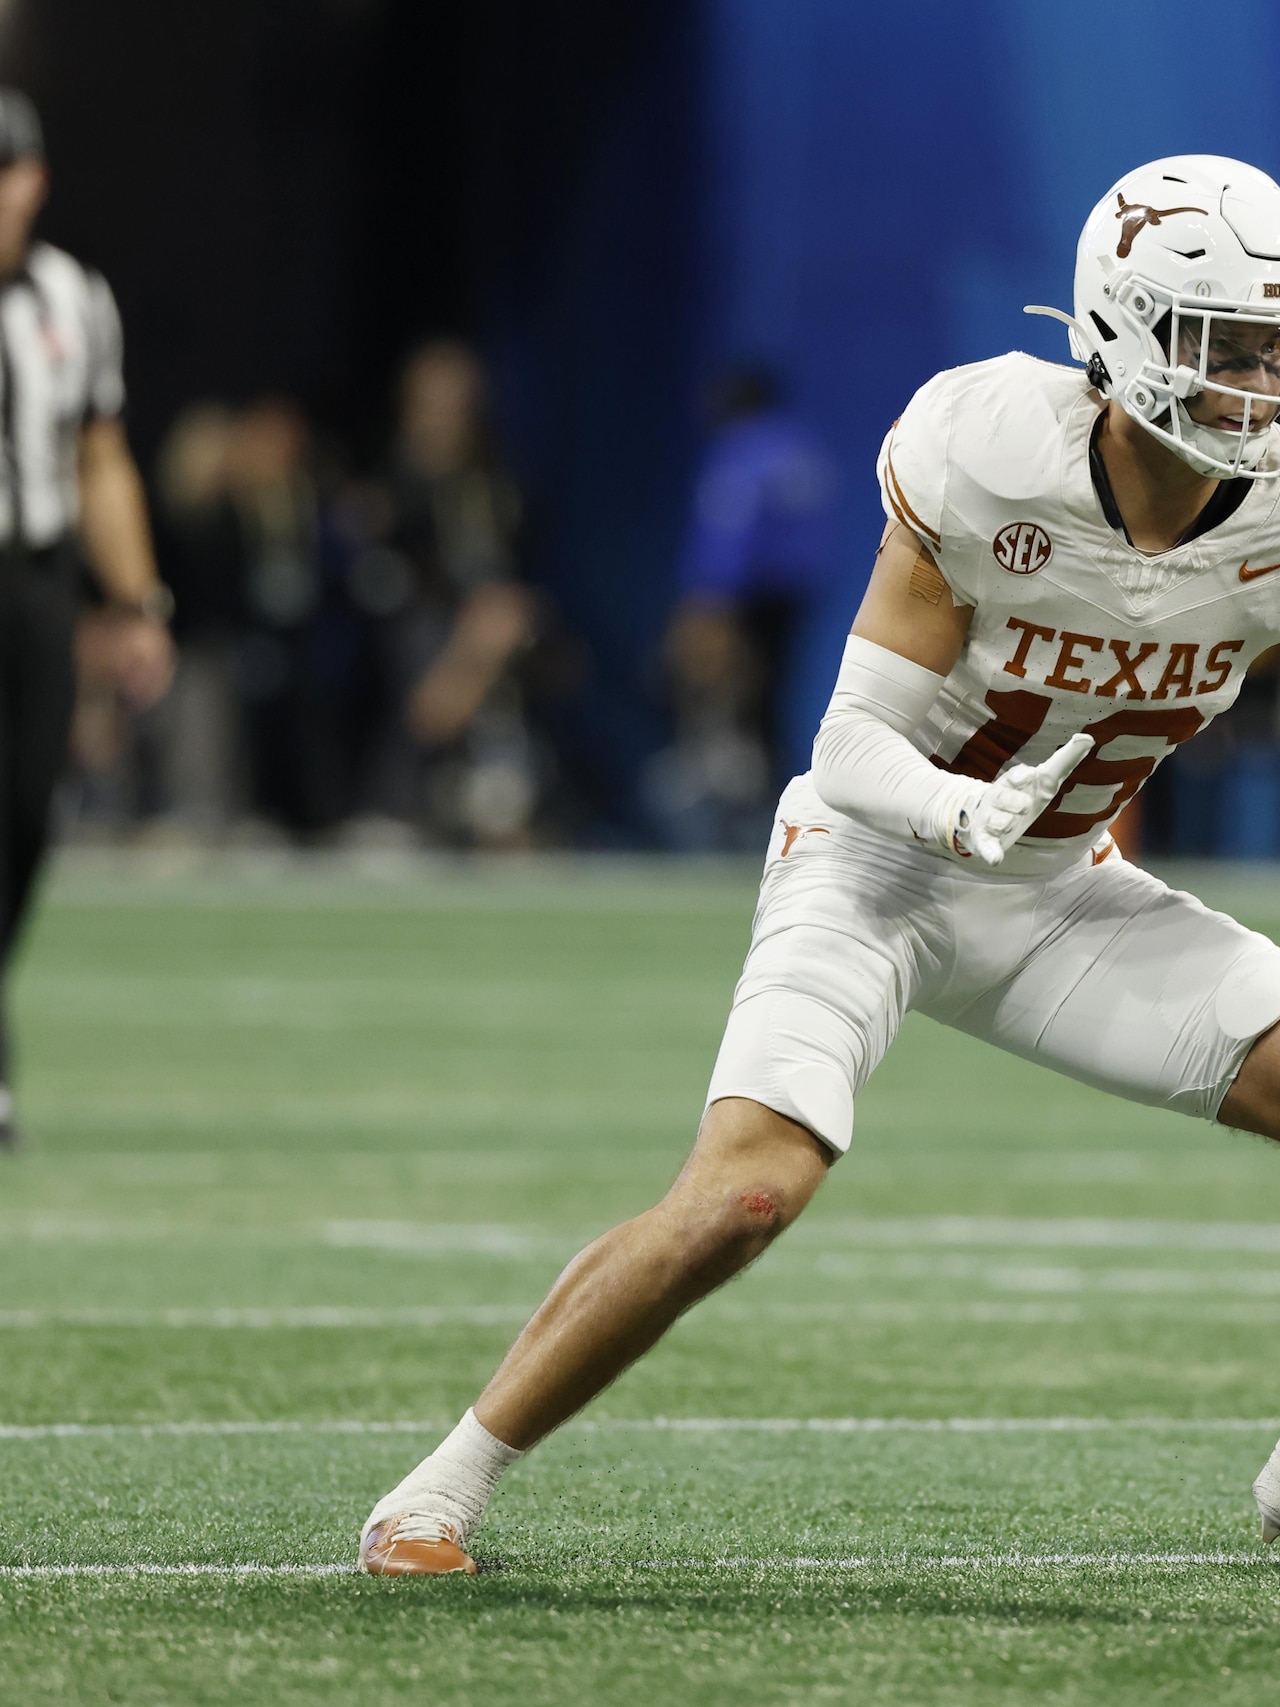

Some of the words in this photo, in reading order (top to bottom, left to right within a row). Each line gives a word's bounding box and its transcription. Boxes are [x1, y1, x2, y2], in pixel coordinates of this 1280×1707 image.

[997, 525, 1048, 572] SEC
[1003, 616, 1245, 700] TEXAS
[929, 689, 1205, 838] 16
